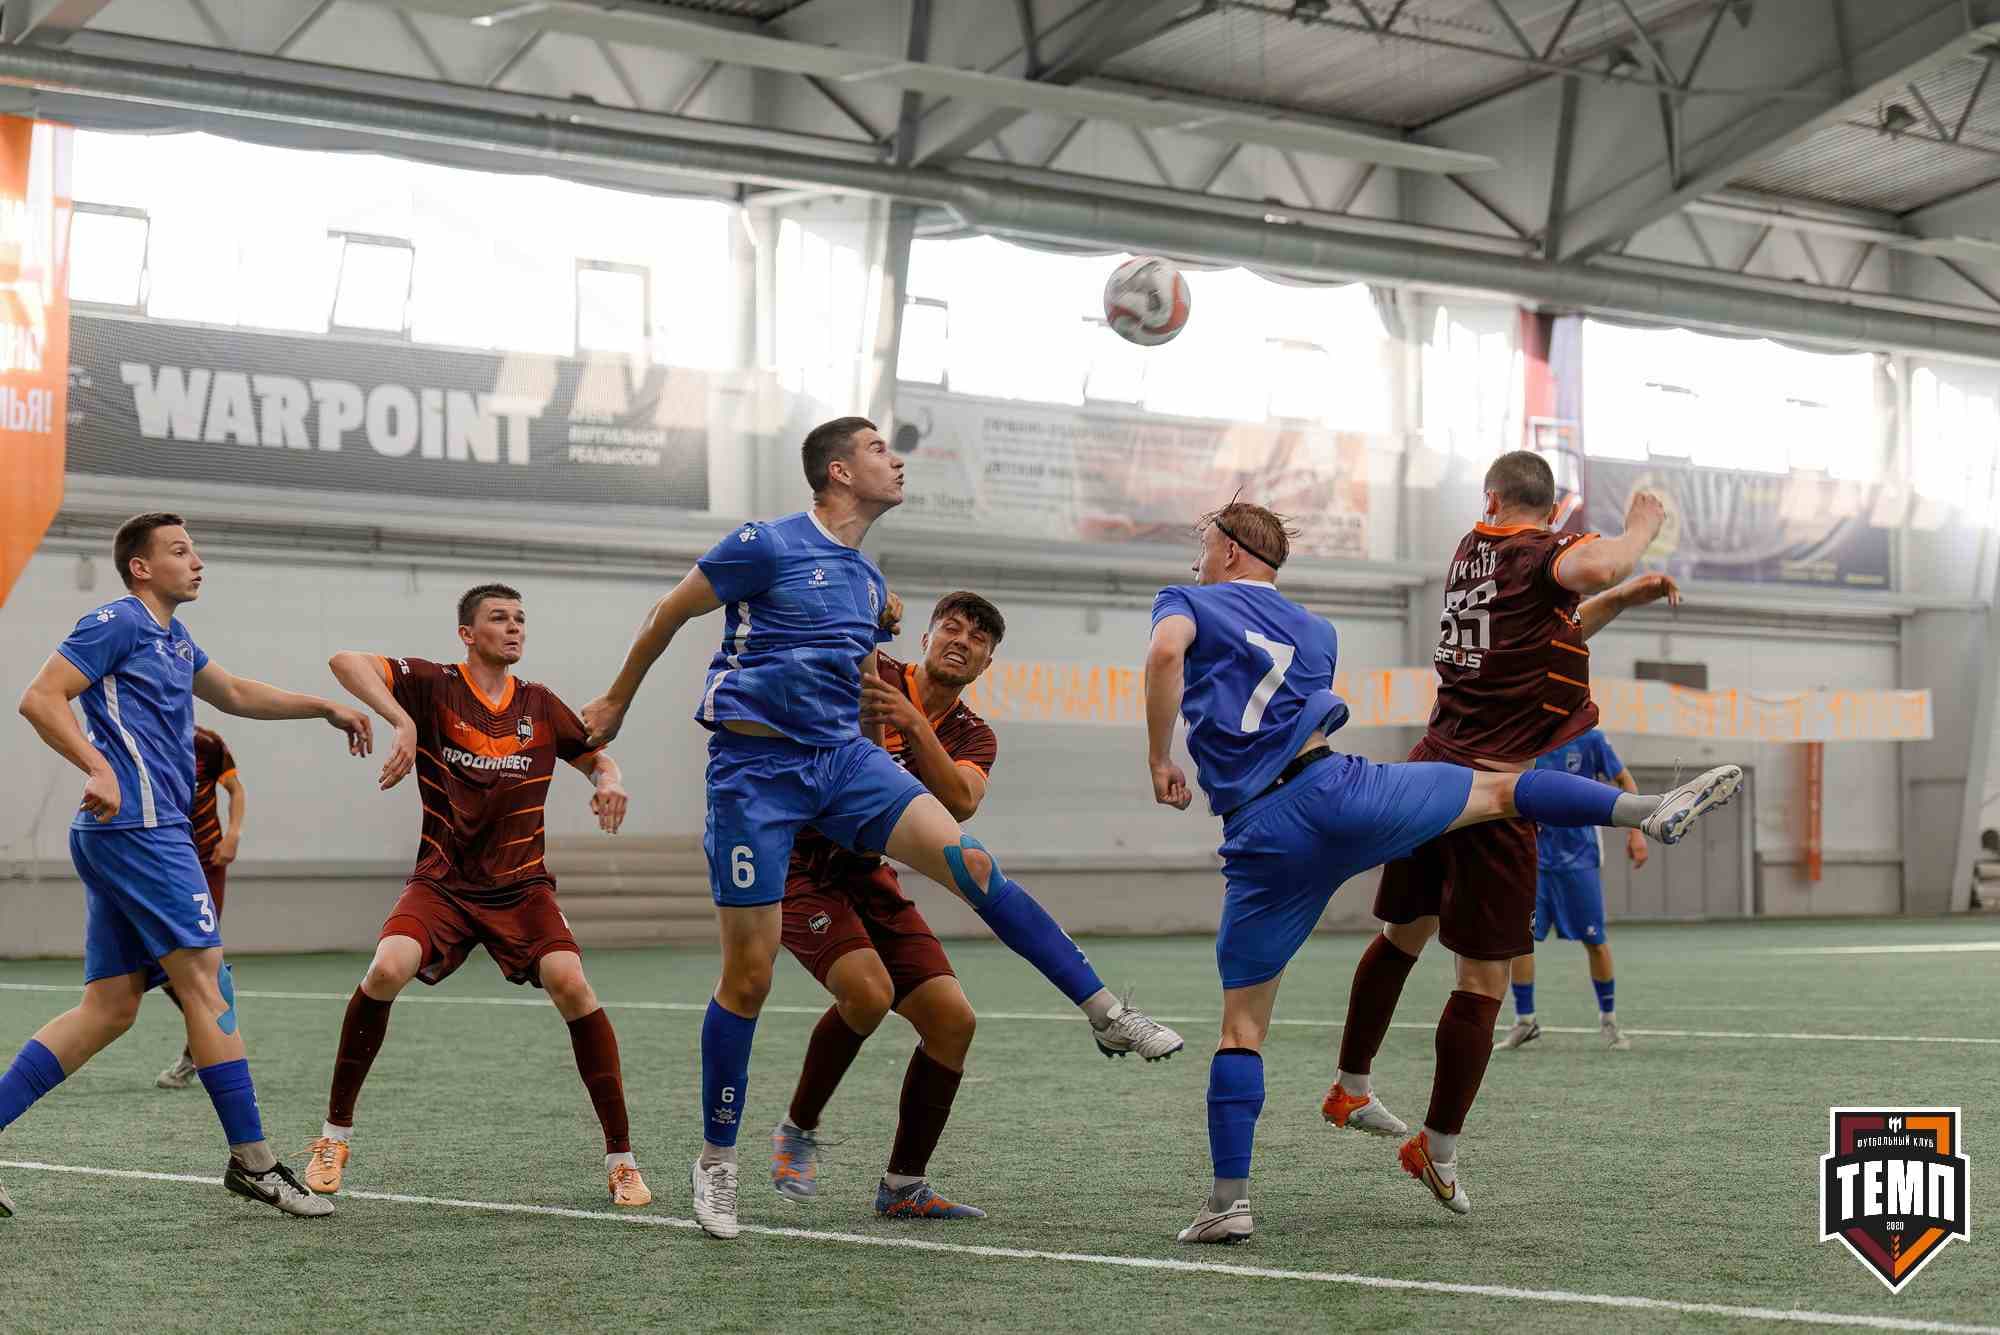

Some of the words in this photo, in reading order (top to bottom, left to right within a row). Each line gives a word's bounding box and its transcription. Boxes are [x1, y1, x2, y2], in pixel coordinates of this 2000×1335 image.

[1240, 629, 1296, 733] 7
[731, 845, 756, 889] 6
[192, 893, 215, 933] 3
[721, 1086, 735, 1104] 6
